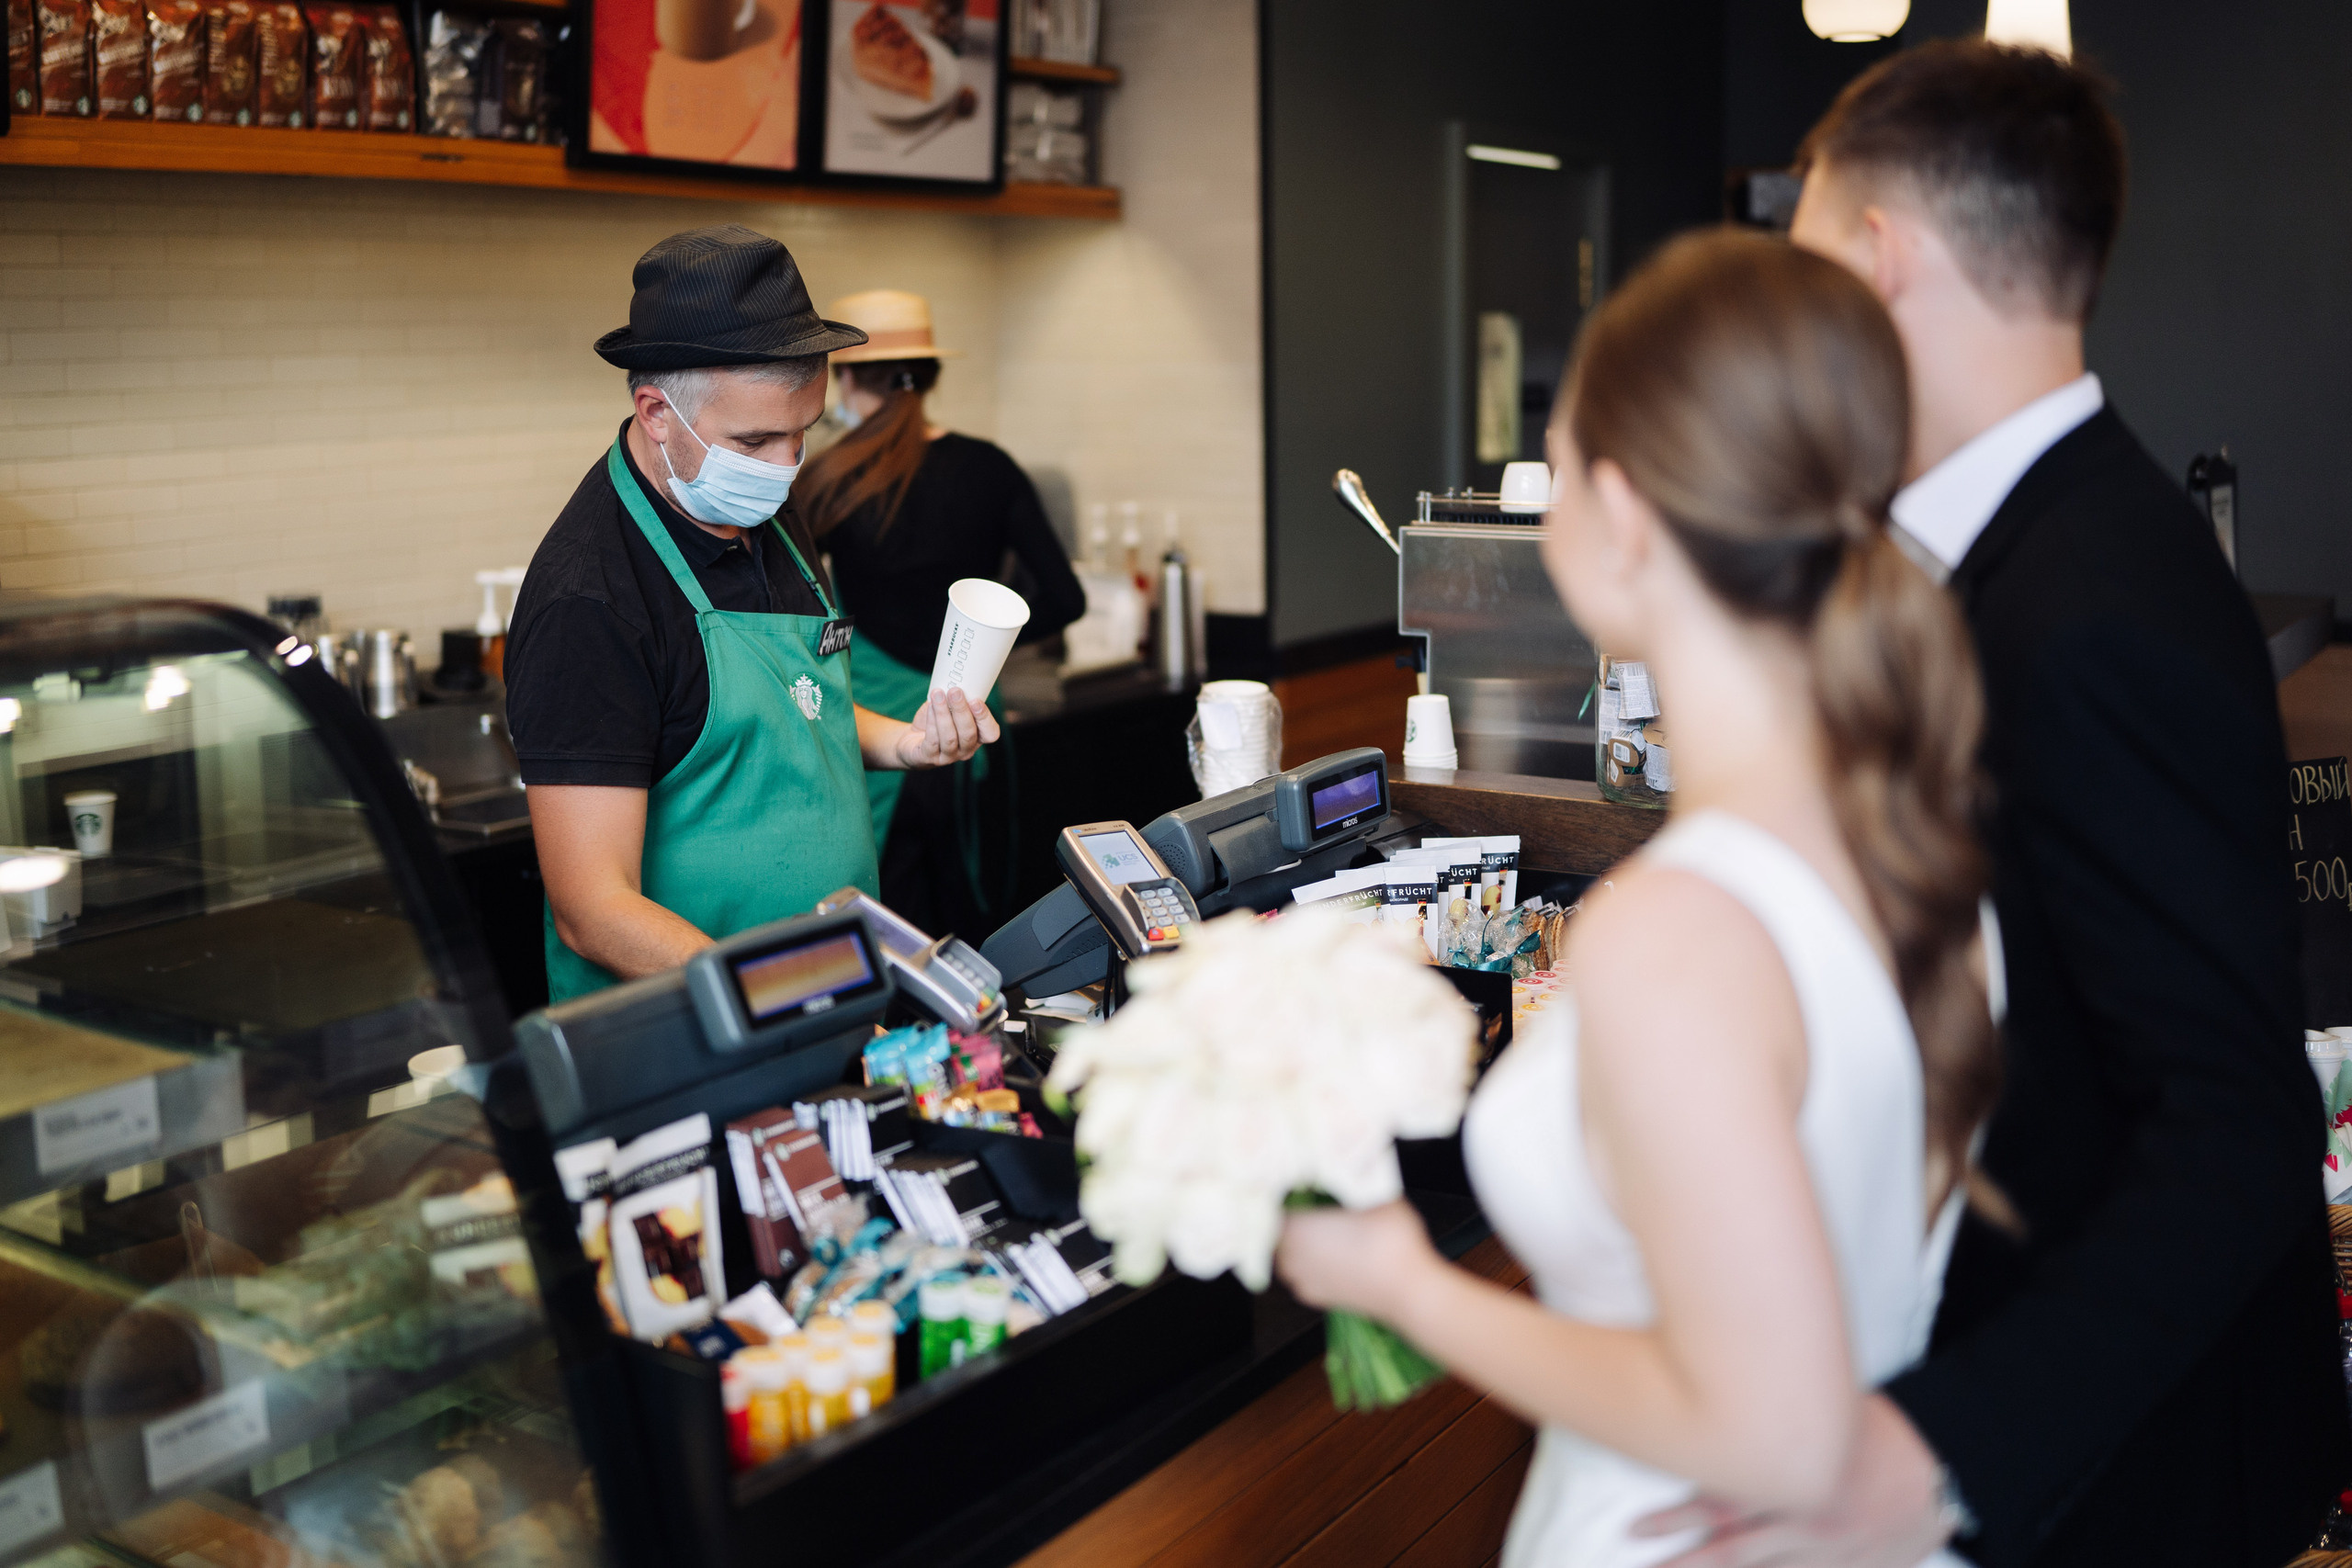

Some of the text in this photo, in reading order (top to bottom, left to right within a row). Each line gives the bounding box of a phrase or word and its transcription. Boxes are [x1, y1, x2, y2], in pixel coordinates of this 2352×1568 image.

[947, 623, 959, 656] STARBUCKS
[2289, 756, 2351, 806] ОВЫЙ
[1342, 816, 1358, 829] micros
[1117, 852, 1138, 862] UCS
[1450, 867, 1477, 876] ÜCHT
